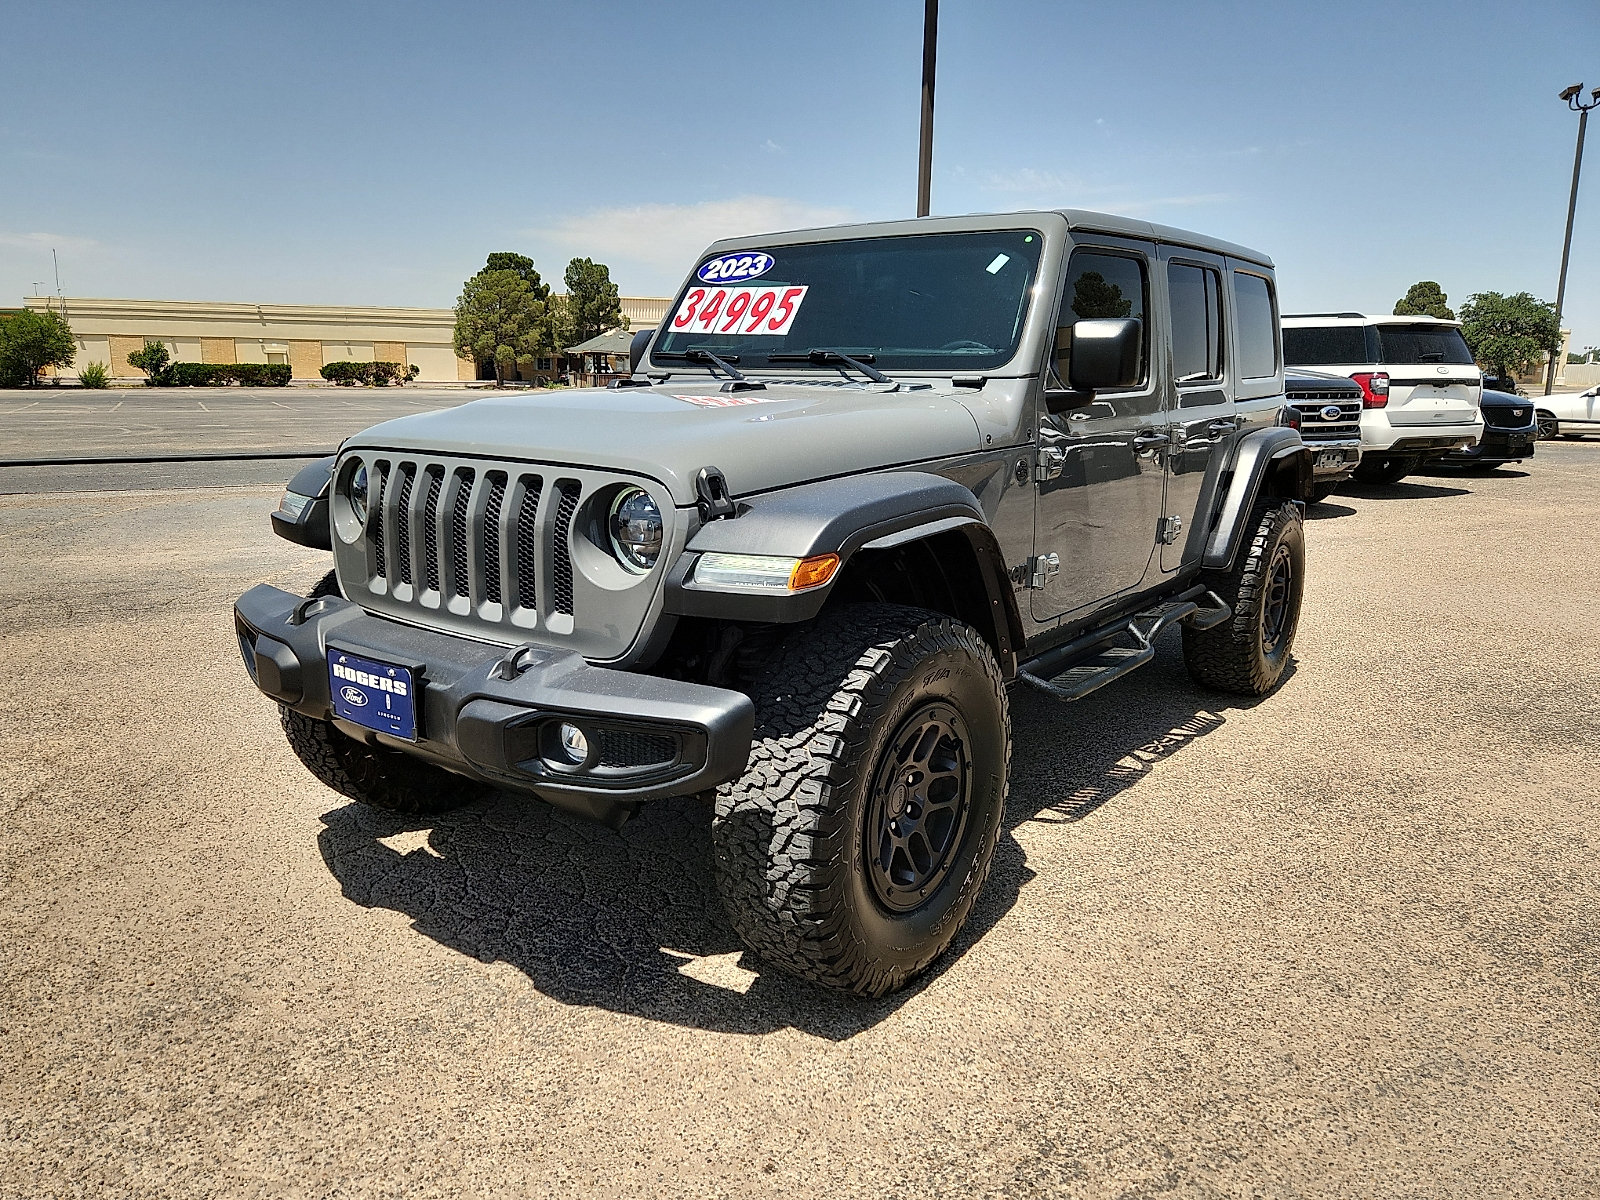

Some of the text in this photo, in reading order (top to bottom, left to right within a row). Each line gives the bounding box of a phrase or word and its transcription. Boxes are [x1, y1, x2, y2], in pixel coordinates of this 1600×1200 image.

[703, 255, 769, 280] 2023
[674, 288, 804, 333] 34995
[332, 663, 407, 696] ROGERS
[344, 687, 364, 705] Ford
